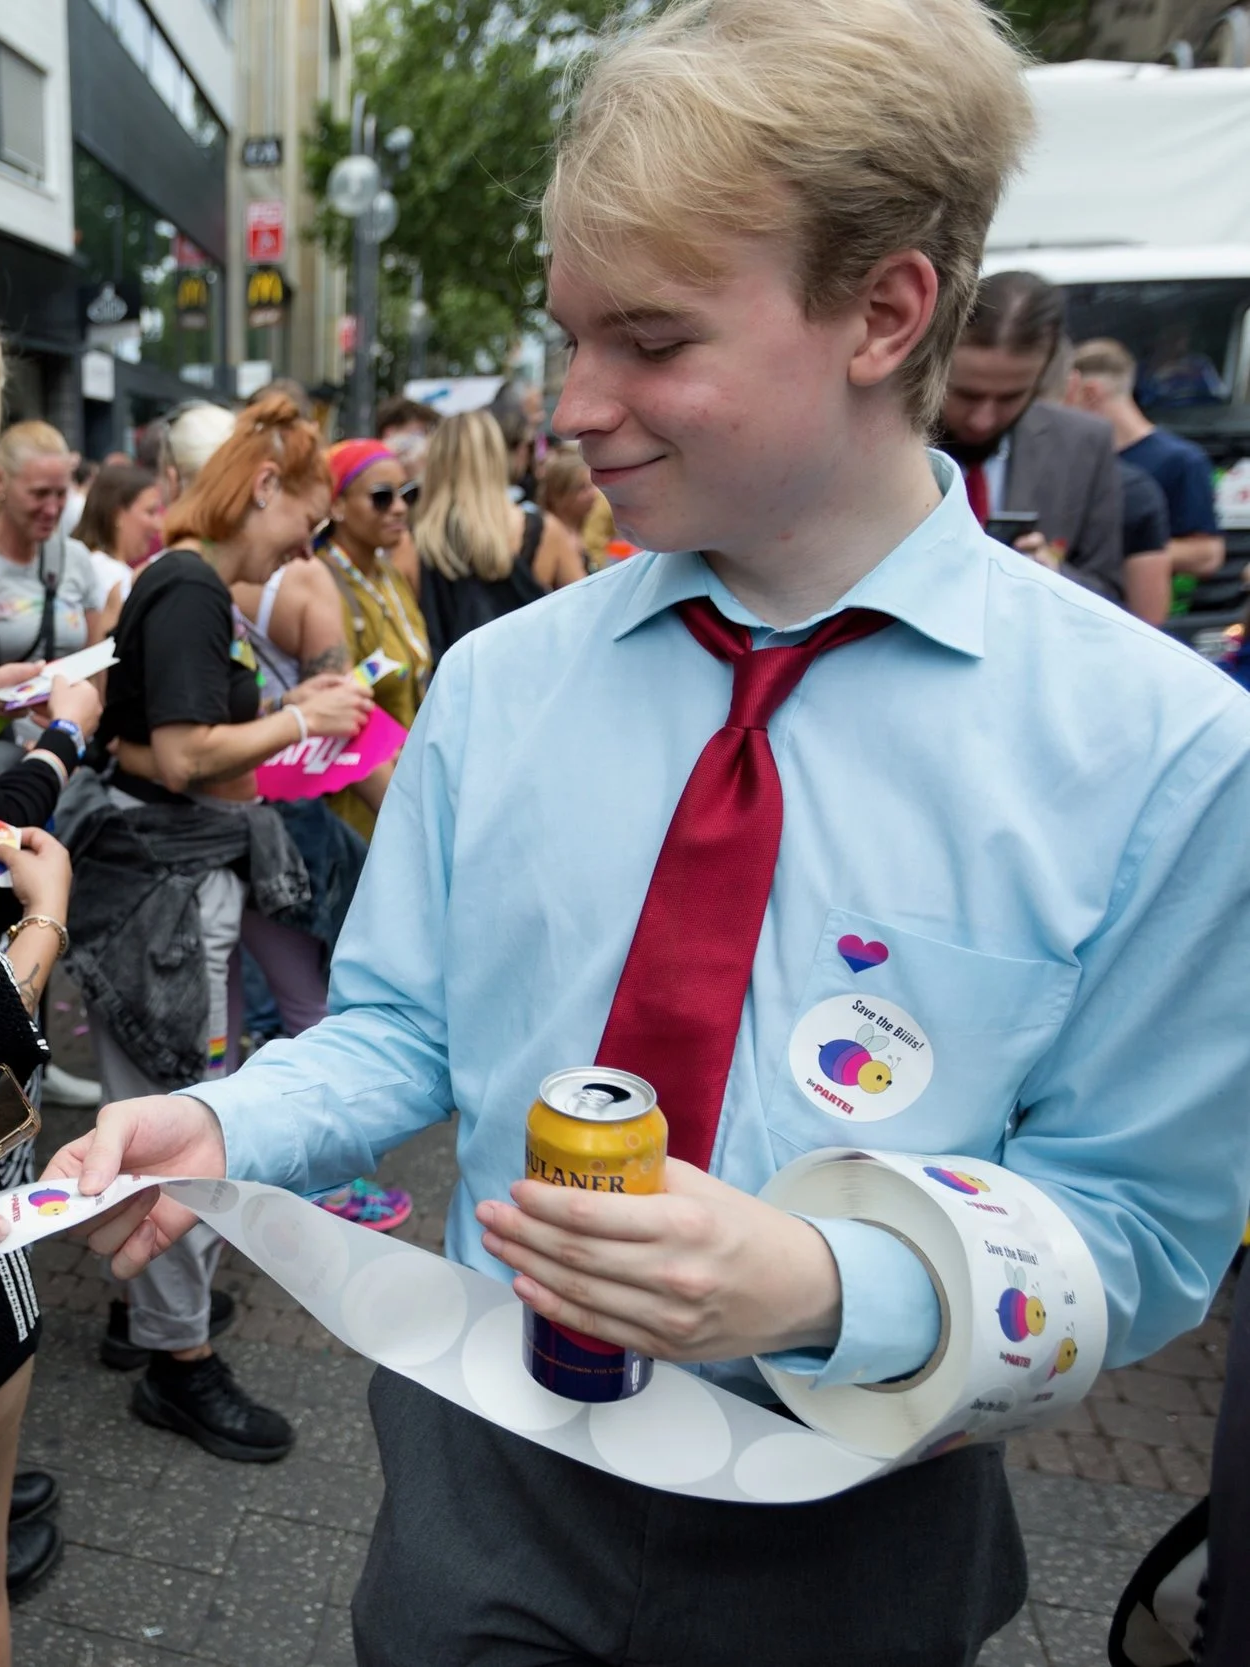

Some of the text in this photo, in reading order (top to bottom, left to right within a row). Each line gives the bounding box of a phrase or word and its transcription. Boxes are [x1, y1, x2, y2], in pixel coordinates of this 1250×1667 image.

[851, 999, 925, 1052] Save the Biiiis!
[806, 1078, 855, 1115] Die PARTEI
[984, 1240, 1004, 1257] Save
[1003, 1245, 1018, 1261] the
